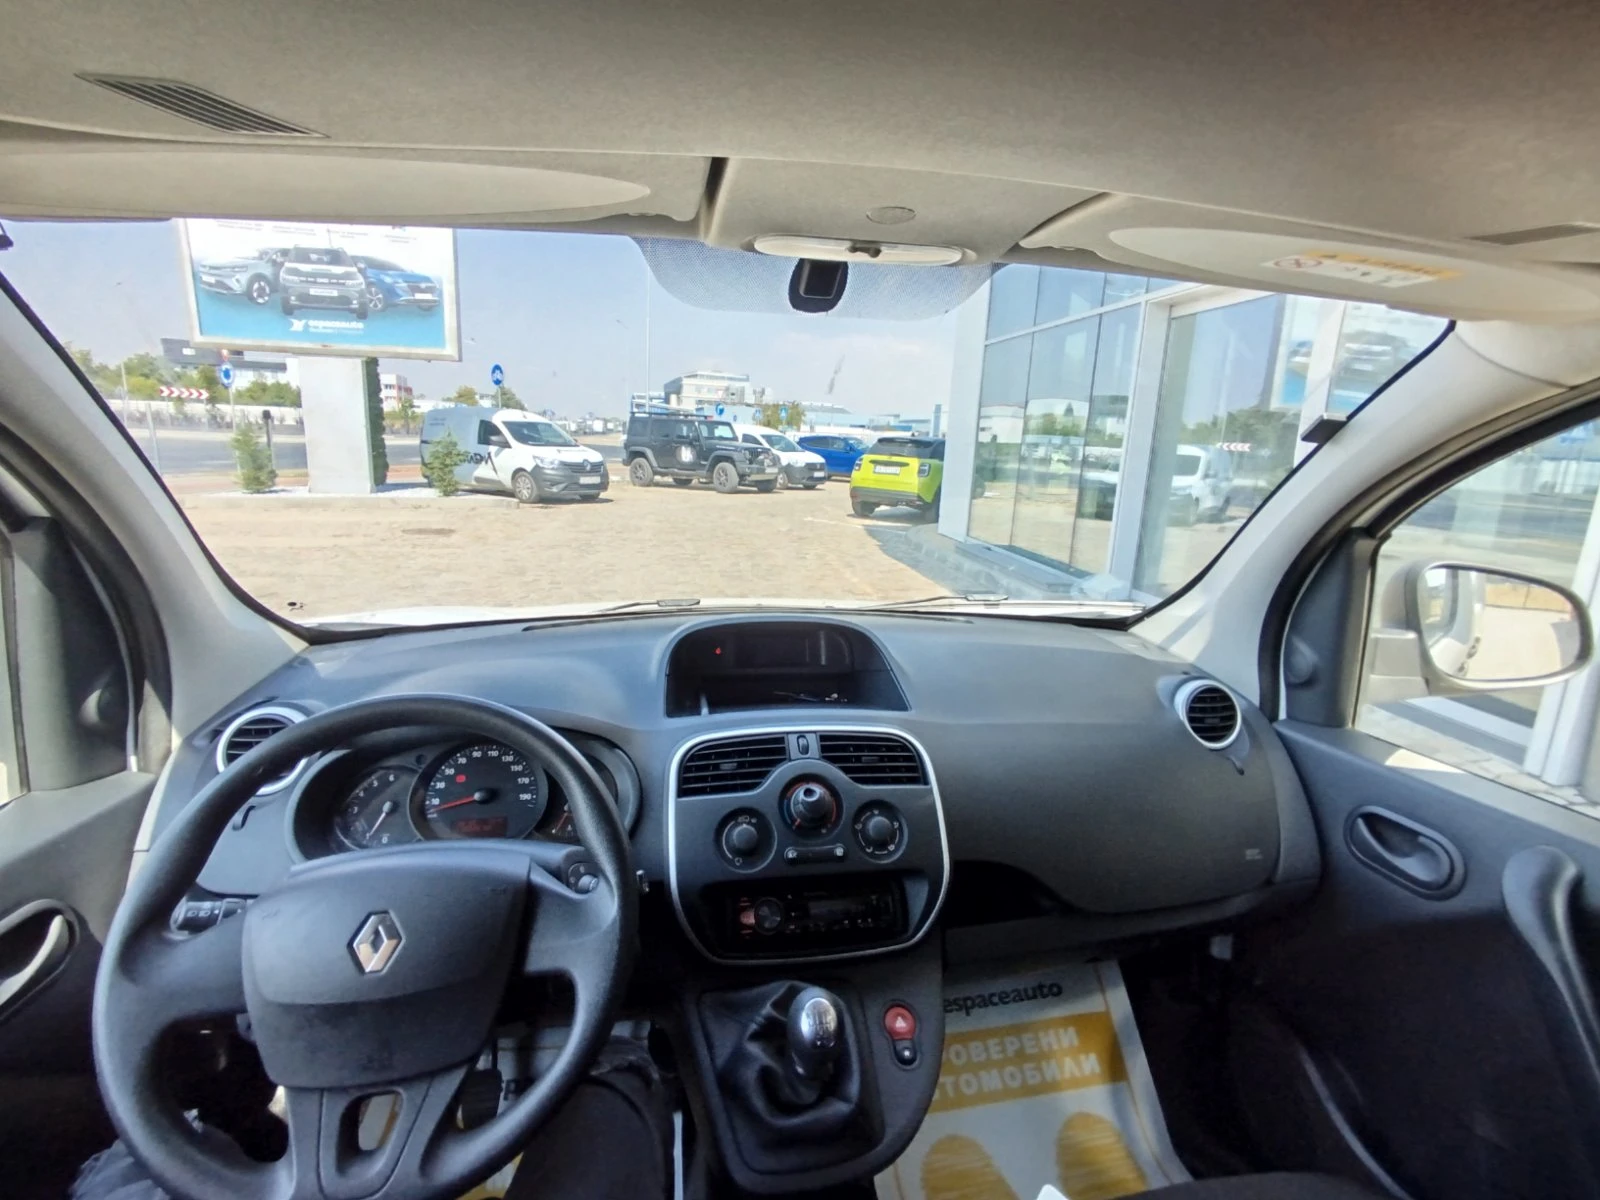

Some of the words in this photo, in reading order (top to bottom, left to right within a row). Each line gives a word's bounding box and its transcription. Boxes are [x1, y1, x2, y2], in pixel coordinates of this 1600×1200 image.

[487, 750, 499, 758] 110
[510, 764, 523, 772] 150
[388, 773, 395, 782] 6
[517, 777, 530, 785] 170
[943, 981, 1063, 1016] espaceauto
[943, 1026, 1079, 1067] ОВЕРЕНИ
